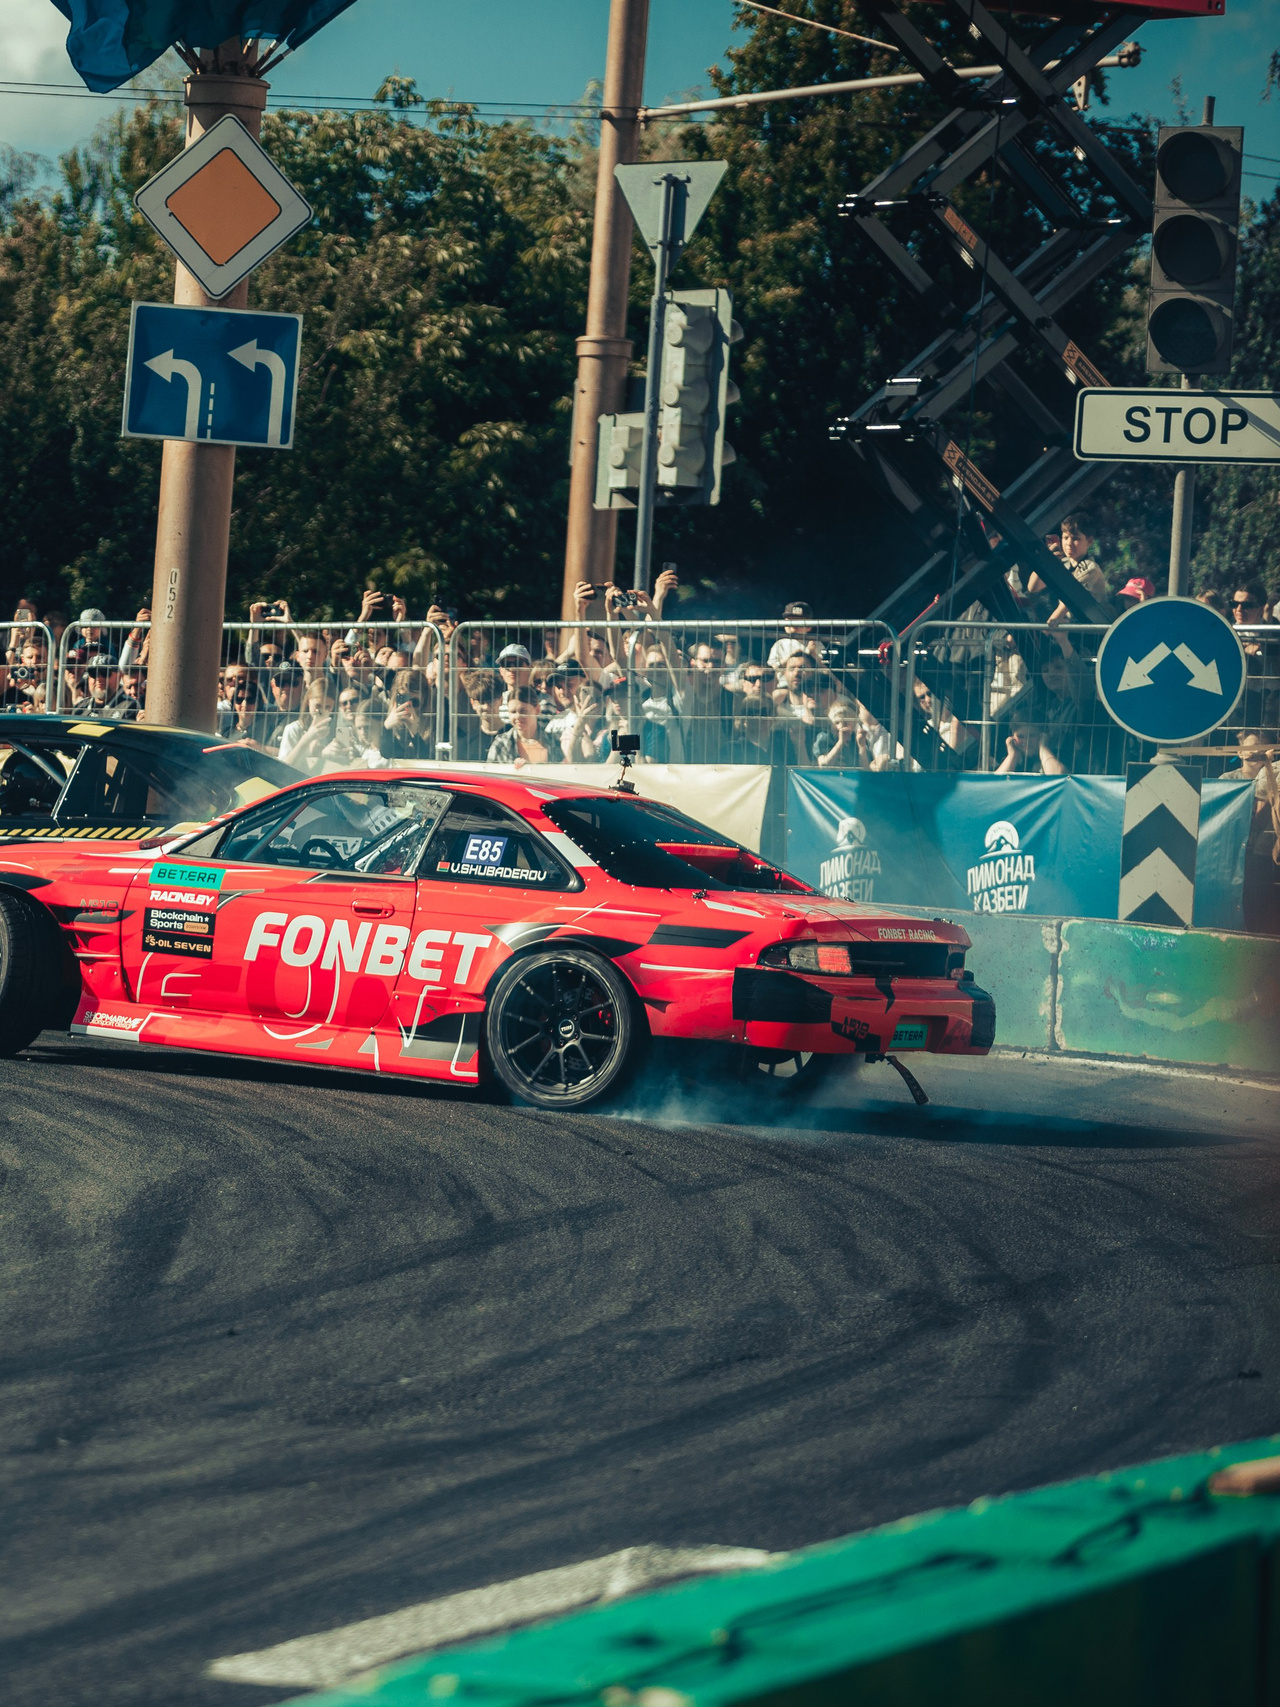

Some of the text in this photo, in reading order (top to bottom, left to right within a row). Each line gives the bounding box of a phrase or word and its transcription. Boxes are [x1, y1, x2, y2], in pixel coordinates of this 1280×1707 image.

[1123, 406, 1249, 445] STOP
[166, 570, 178, 619] 052
[465, 839, 504, 862] E85
[157, 868, 217, 884] BET.ERA
[450, 862, 548, 882] V.SHUBADEROV
[819, 850, 882, 889] ЛИМОНАД
[967, 855, 1036, 896] ЛИМОНАД
[149, 890, 215, 906] RACING.BY
[973, 884, 1029, 913] КАЗБЕГИ
[149, 918, 184, 930] Sports
[150, 909, 204, 923] Blockchain
[877, 927, 936, 941] FONBET RACING
[173, 941, 211, 953] SEVEN
[243, 911, 493, 985] FONBET
[84, 1011, 132, 1023] SHOPMARKA
[892, 1030, 924, 1041] BET.ERA
